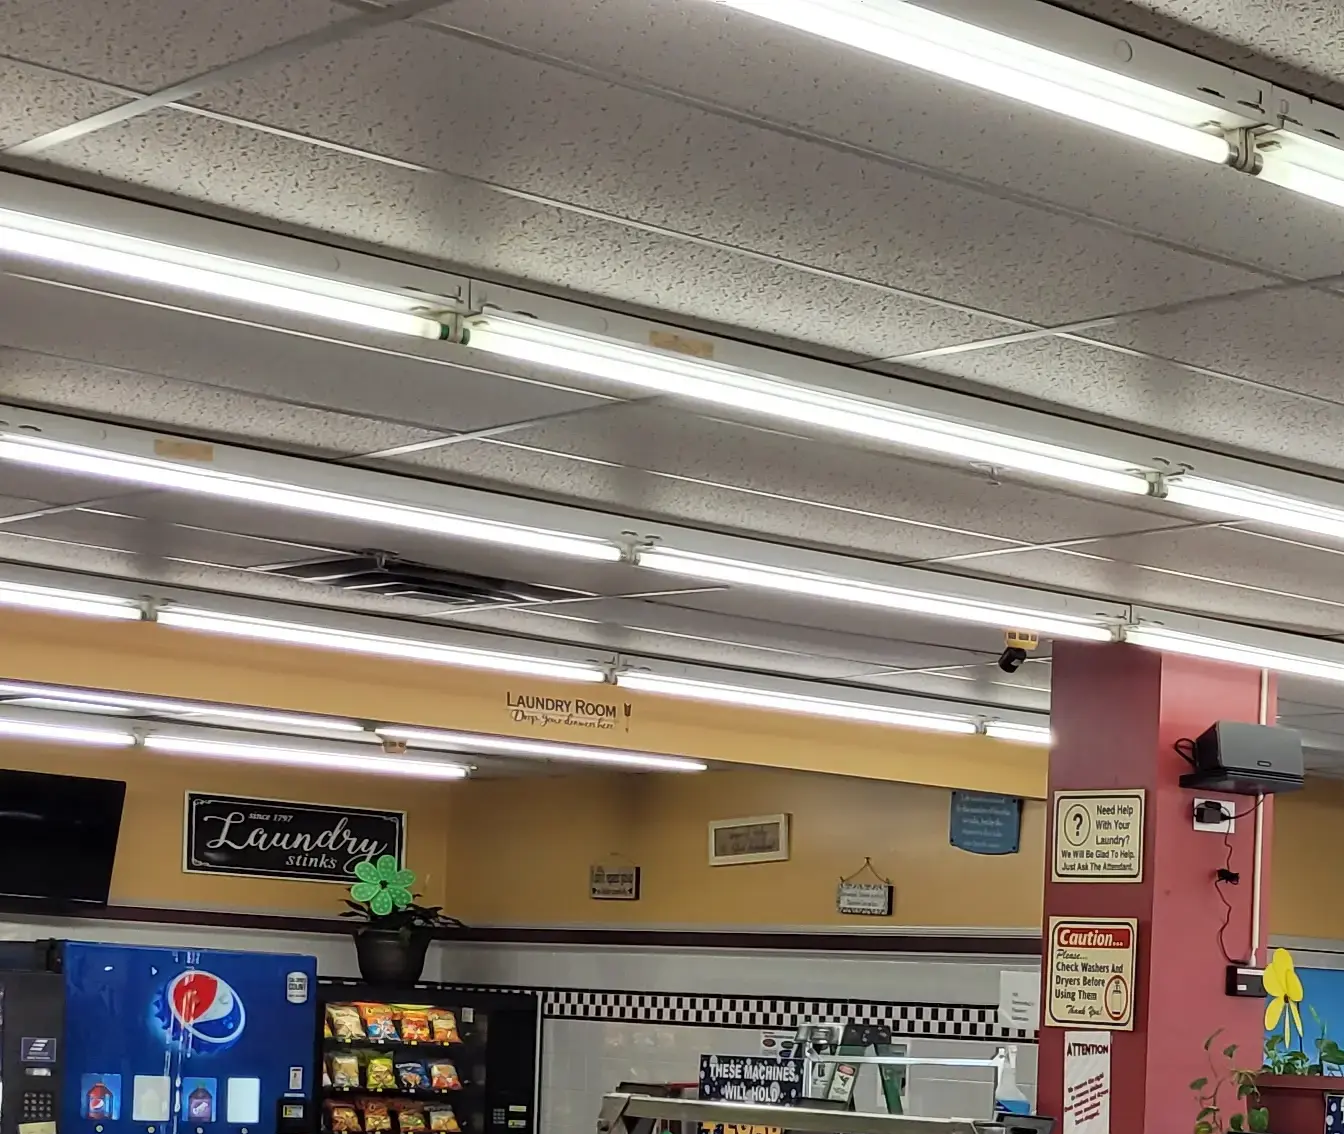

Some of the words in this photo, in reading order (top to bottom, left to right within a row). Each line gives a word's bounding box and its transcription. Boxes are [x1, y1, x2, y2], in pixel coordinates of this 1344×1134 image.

[506, 692, 571, 713] LAUNDRY
[575, 699, 616, 718] ROOM
[248, 811, 271, 822] since
[1096, 804, 1116, 816] Need
[1117, 804, 1134, 818] Help
[1095, 819, 1112, 830] With
[1113, 819, 1130, 830] Your
[203, 811, 388, 874] Laundry
[1095, 834, 1131, 847] Laundry?
[286, 852, 337, 870] stinks
[1061, 849, 1072, 859] We
[1072, 849, 1085, 859] Will
[1085, 849, 1094, 859] Be
[1095, 849, 1110, 859] Glad
[1111, 849, 1119, 859] To
[1061, 862, 1076, 871] Just
[1076, 862, 1089, 871] Ask
[1090, 862, 1101, 871] The
[1059, 928, 1124, 947] Caution...
[1056, 961, 1079, 972] Check
[1081, 962, 1110, 974] Washers
[1110, 963, 1124, 974] And
[1055, 974, 1081, 987] Dryers
[1082, 975, 1106, 987] Before
[1054, 988, 1076, 1002] Using
[1077, 989, 1098, 1001] Them
[1065, 1004, 1086, 1016] Thank
[1066, 1042, 1109, 1057] ATTENTION
[709, 1062, 742, 1080] THESE
[743, 1064, 796, 1083] MACHINES
[724, 1084, 747, 1100] WILL
[751, 1086, 779, 1102] HOLD
